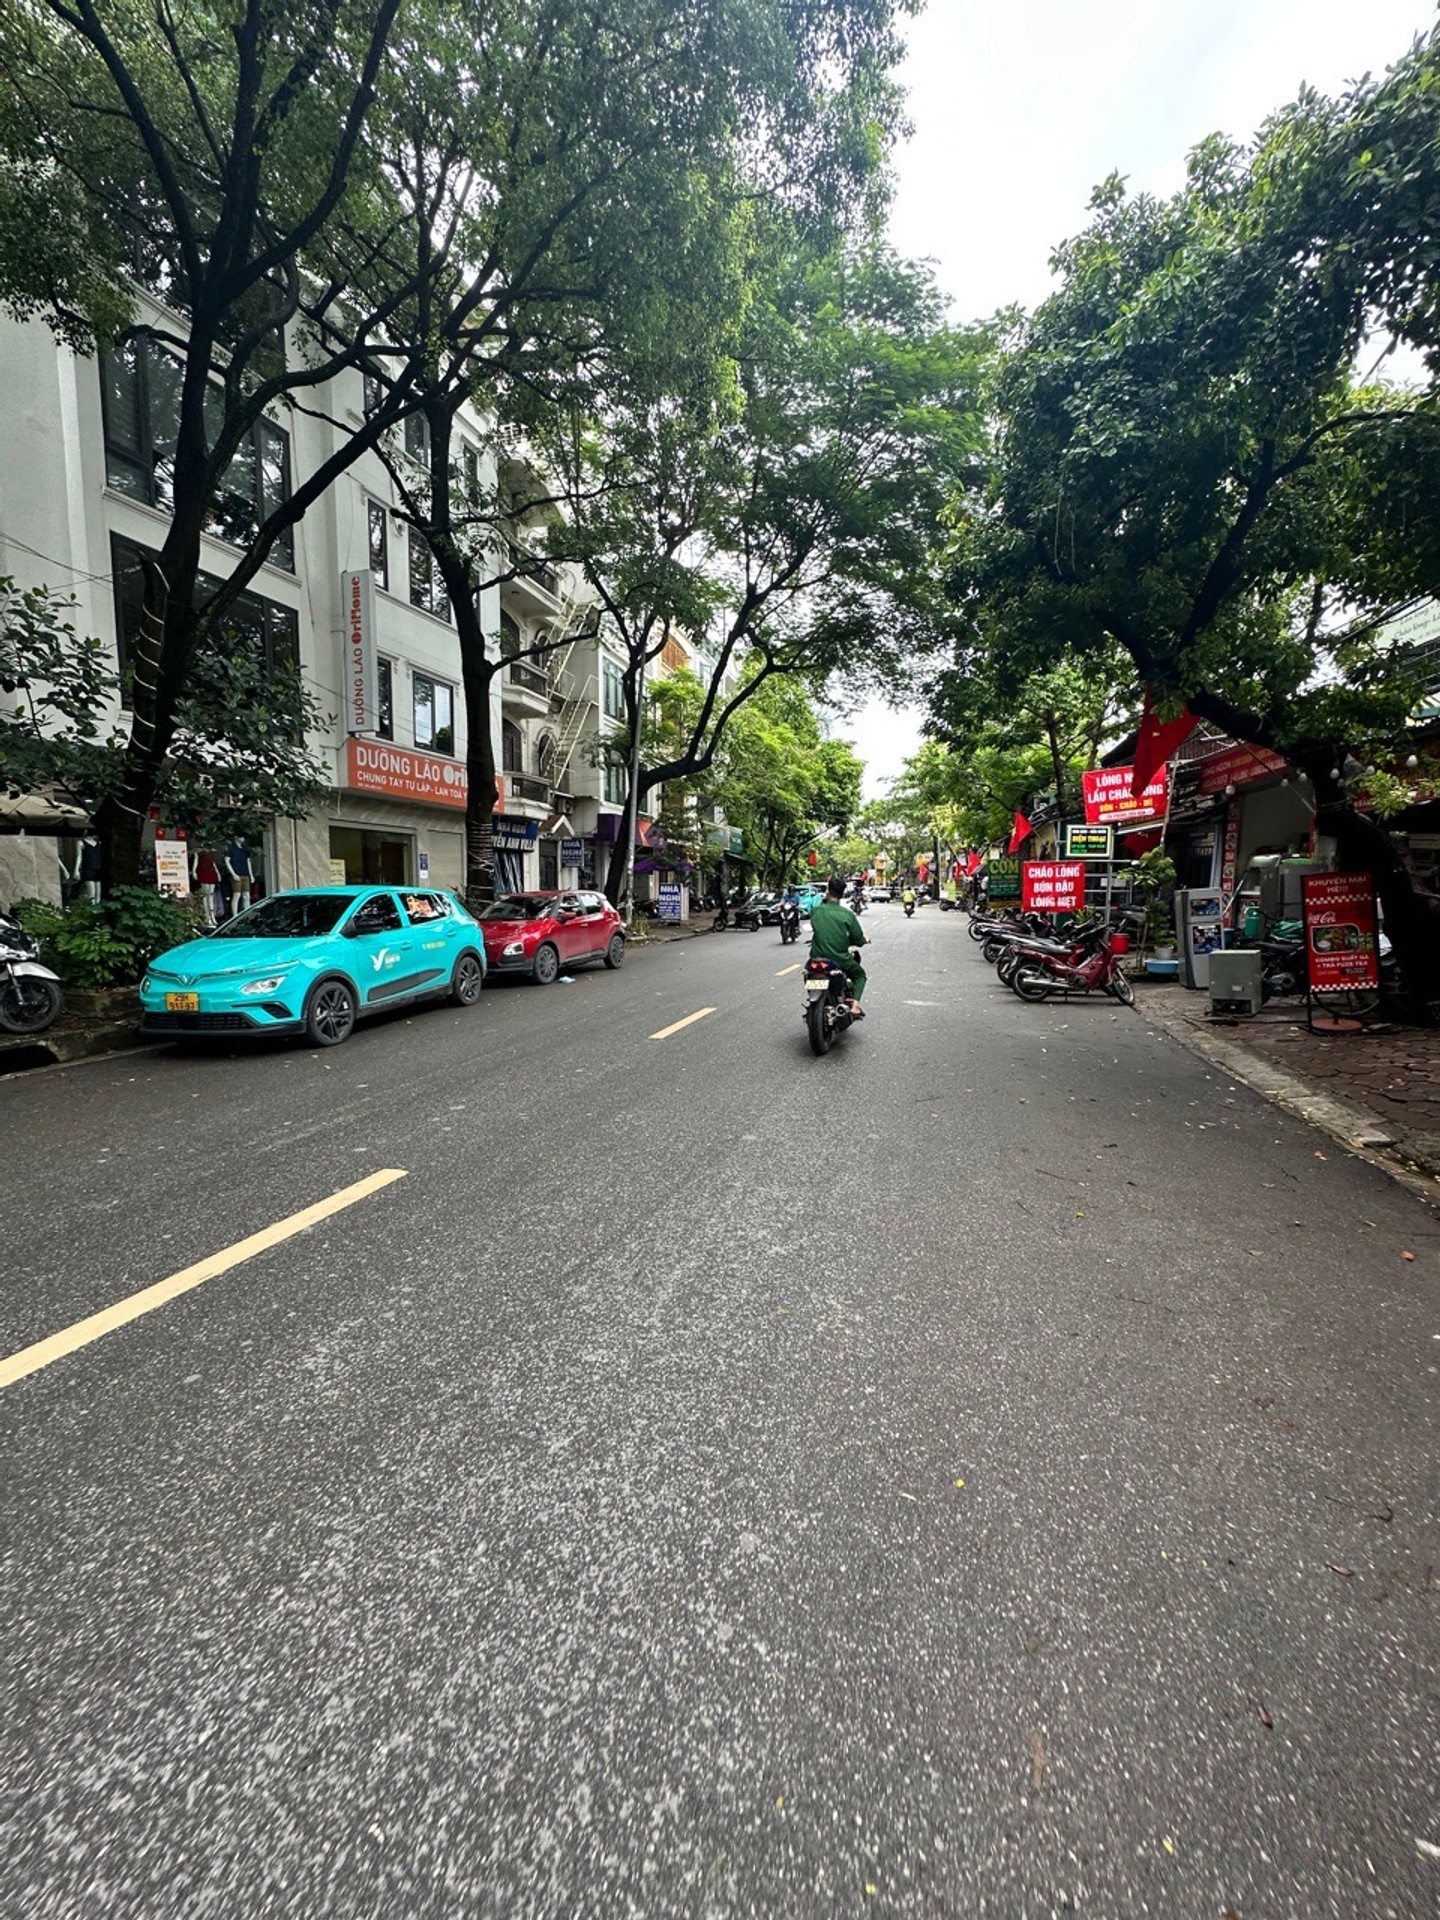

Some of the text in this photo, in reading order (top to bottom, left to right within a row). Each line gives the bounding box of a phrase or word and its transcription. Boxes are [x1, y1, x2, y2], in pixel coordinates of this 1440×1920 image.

[351, 576, 362, 645] OriHome
[353, 647, 363, 674] LÃO
[356, 746, 411, 776] DƯỠNG
[414, 759, 440, 782] LÃO
[357, 770, 387, 784] CHUNG
[389, 777, 403, 788] TAY
[435, 786, 449, 797] LAN
[1096, 773, 1122, 787] LÒNG
[1028, 865, 1053, 879] CHÁO
[1055, 864, 1080, 878] LÒNG
[1033, 880, 1074, 894] BÚN ĐẬU
